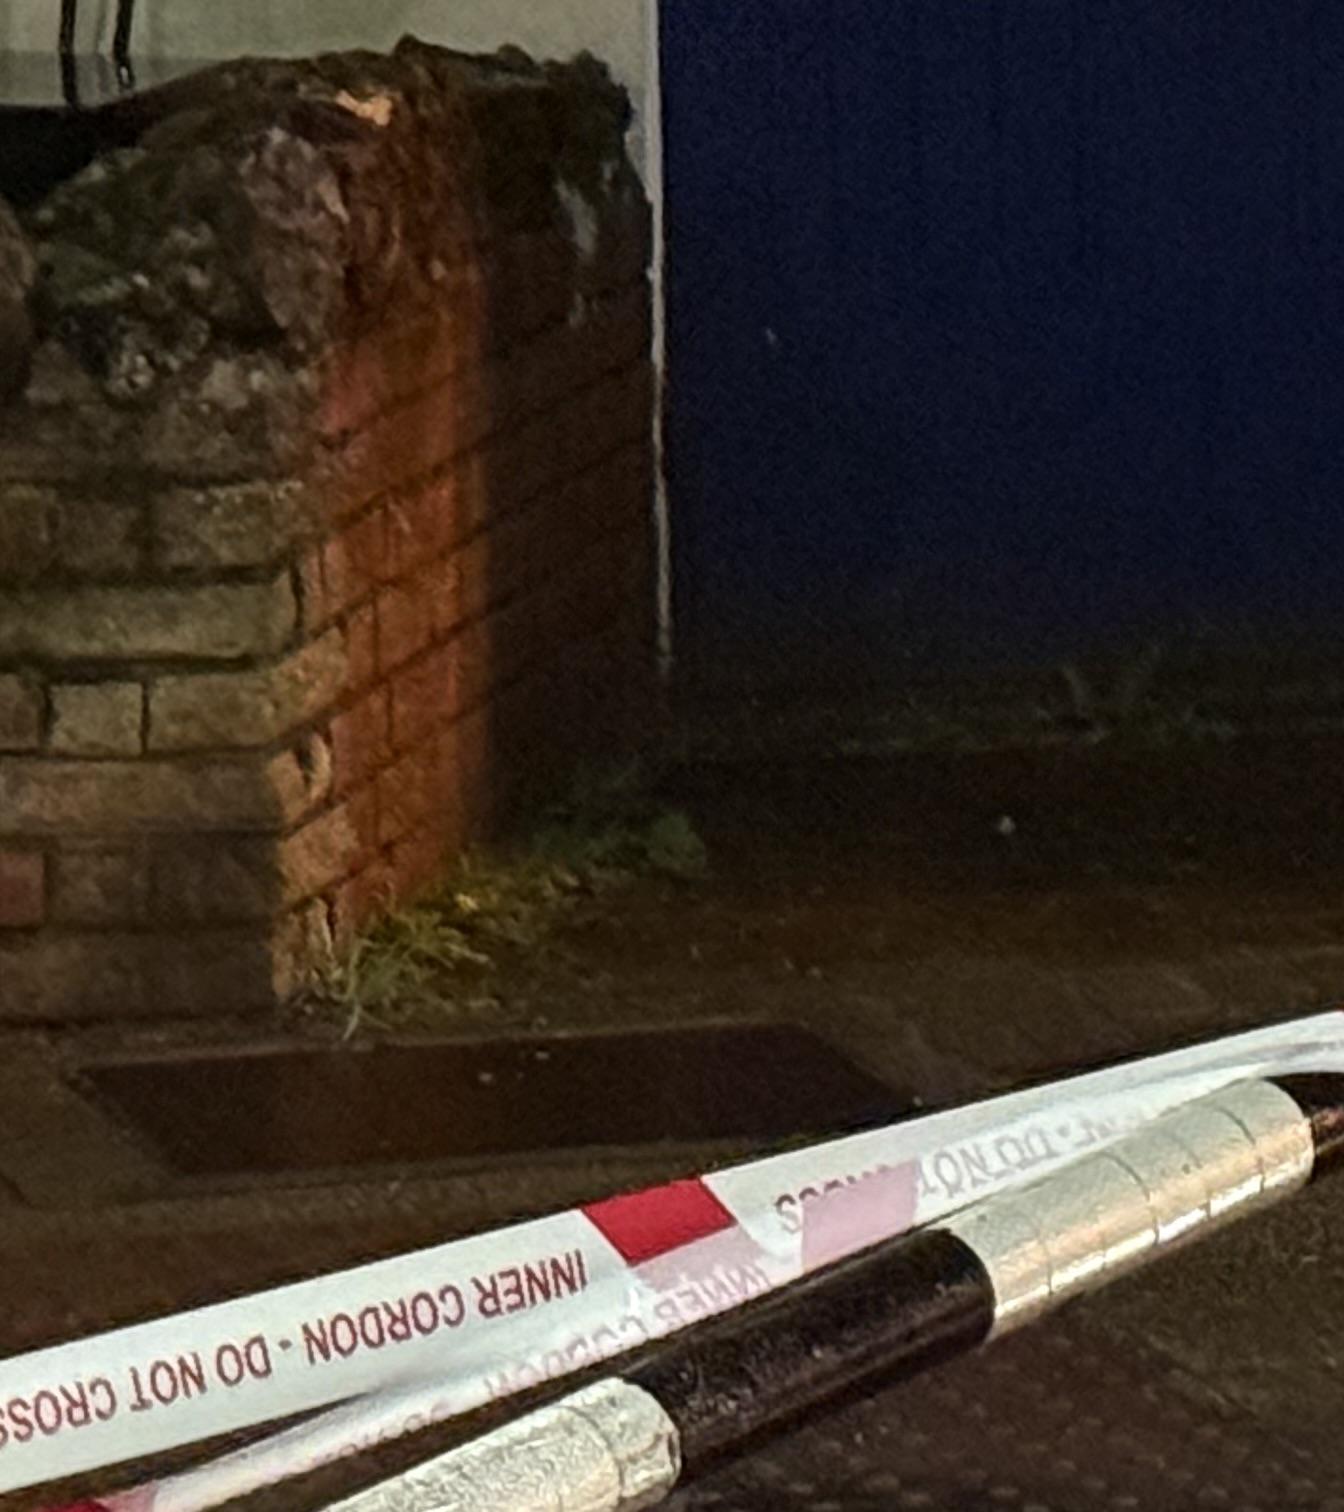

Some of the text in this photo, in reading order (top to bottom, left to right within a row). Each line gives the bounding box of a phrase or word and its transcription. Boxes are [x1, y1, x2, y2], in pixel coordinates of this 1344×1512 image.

[476, 1248, 589, 1318] INNER
[301, 1283, 467, 1365] CORDON
[128, 1351, 208, 1413] NOT
[215, 1334, 273, 1388] DO
